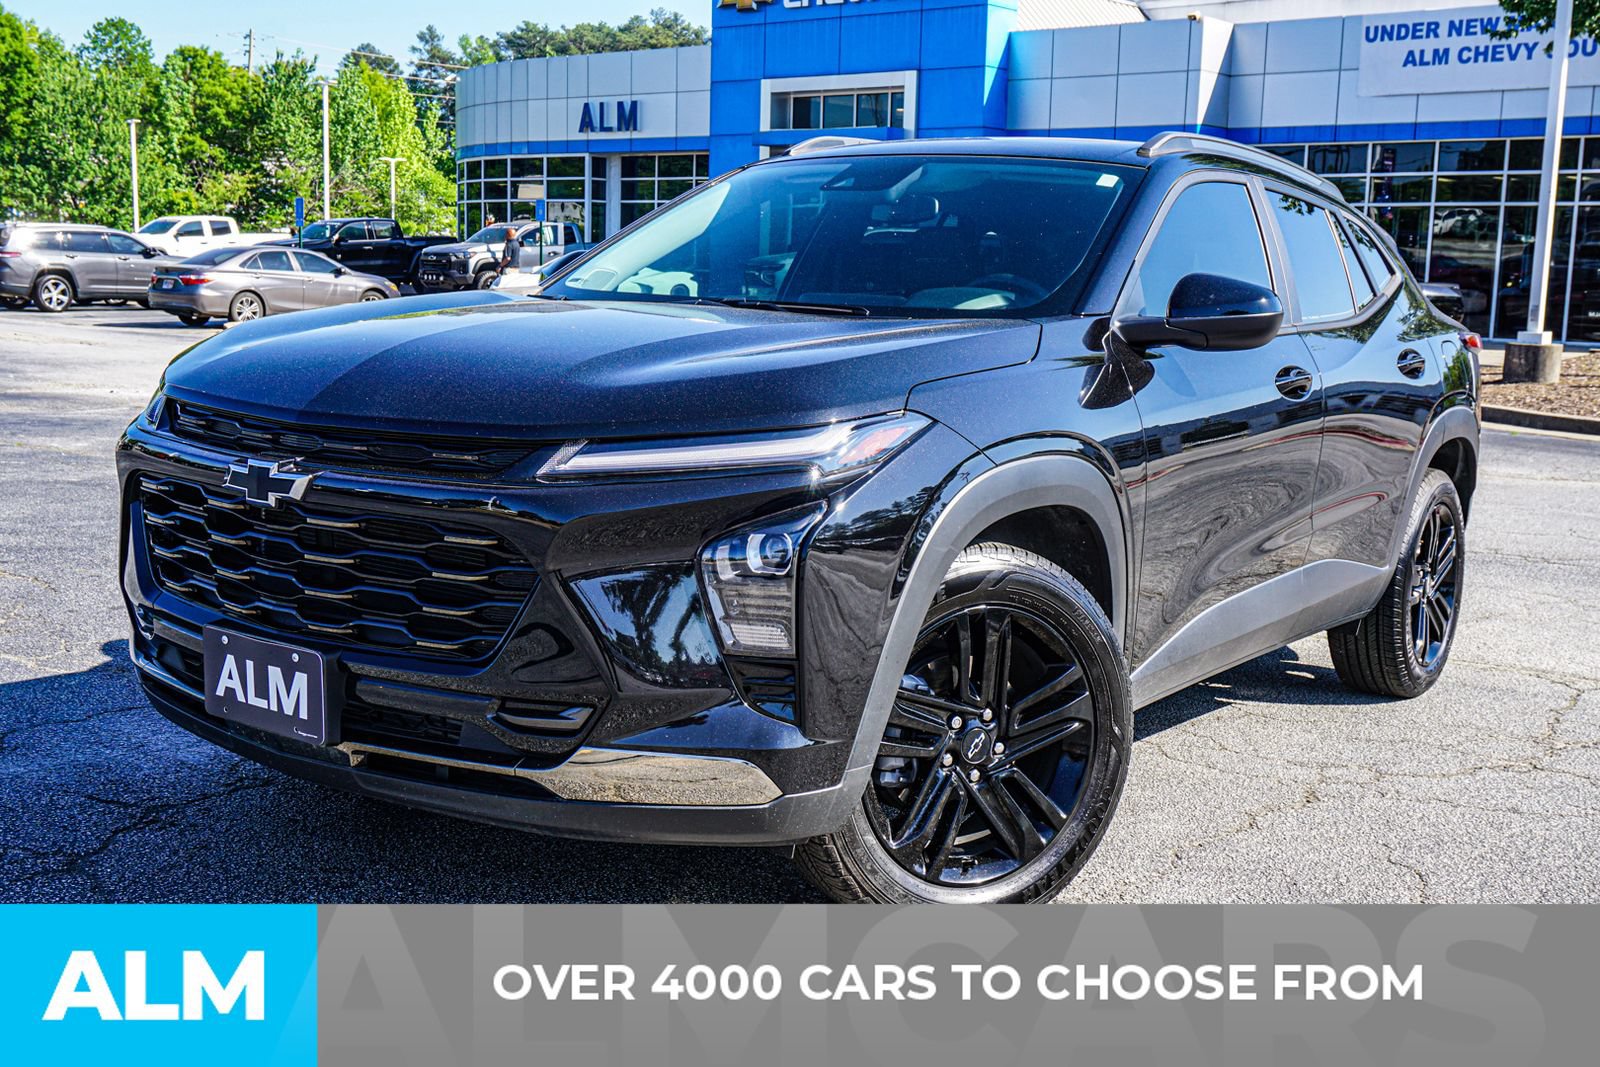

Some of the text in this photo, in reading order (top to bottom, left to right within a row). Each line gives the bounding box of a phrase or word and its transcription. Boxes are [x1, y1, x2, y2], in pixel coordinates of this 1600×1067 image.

[1365, 20, 1440, 43] UNDER
[1447, 16, 1501, 37] NEW
[1402, 47, 1450, 67] ALM
[1457, 41, 1540, 64] CHEVY
[578, 100, 638, 133] ALM
[215, 653, 308, 720] ALM
